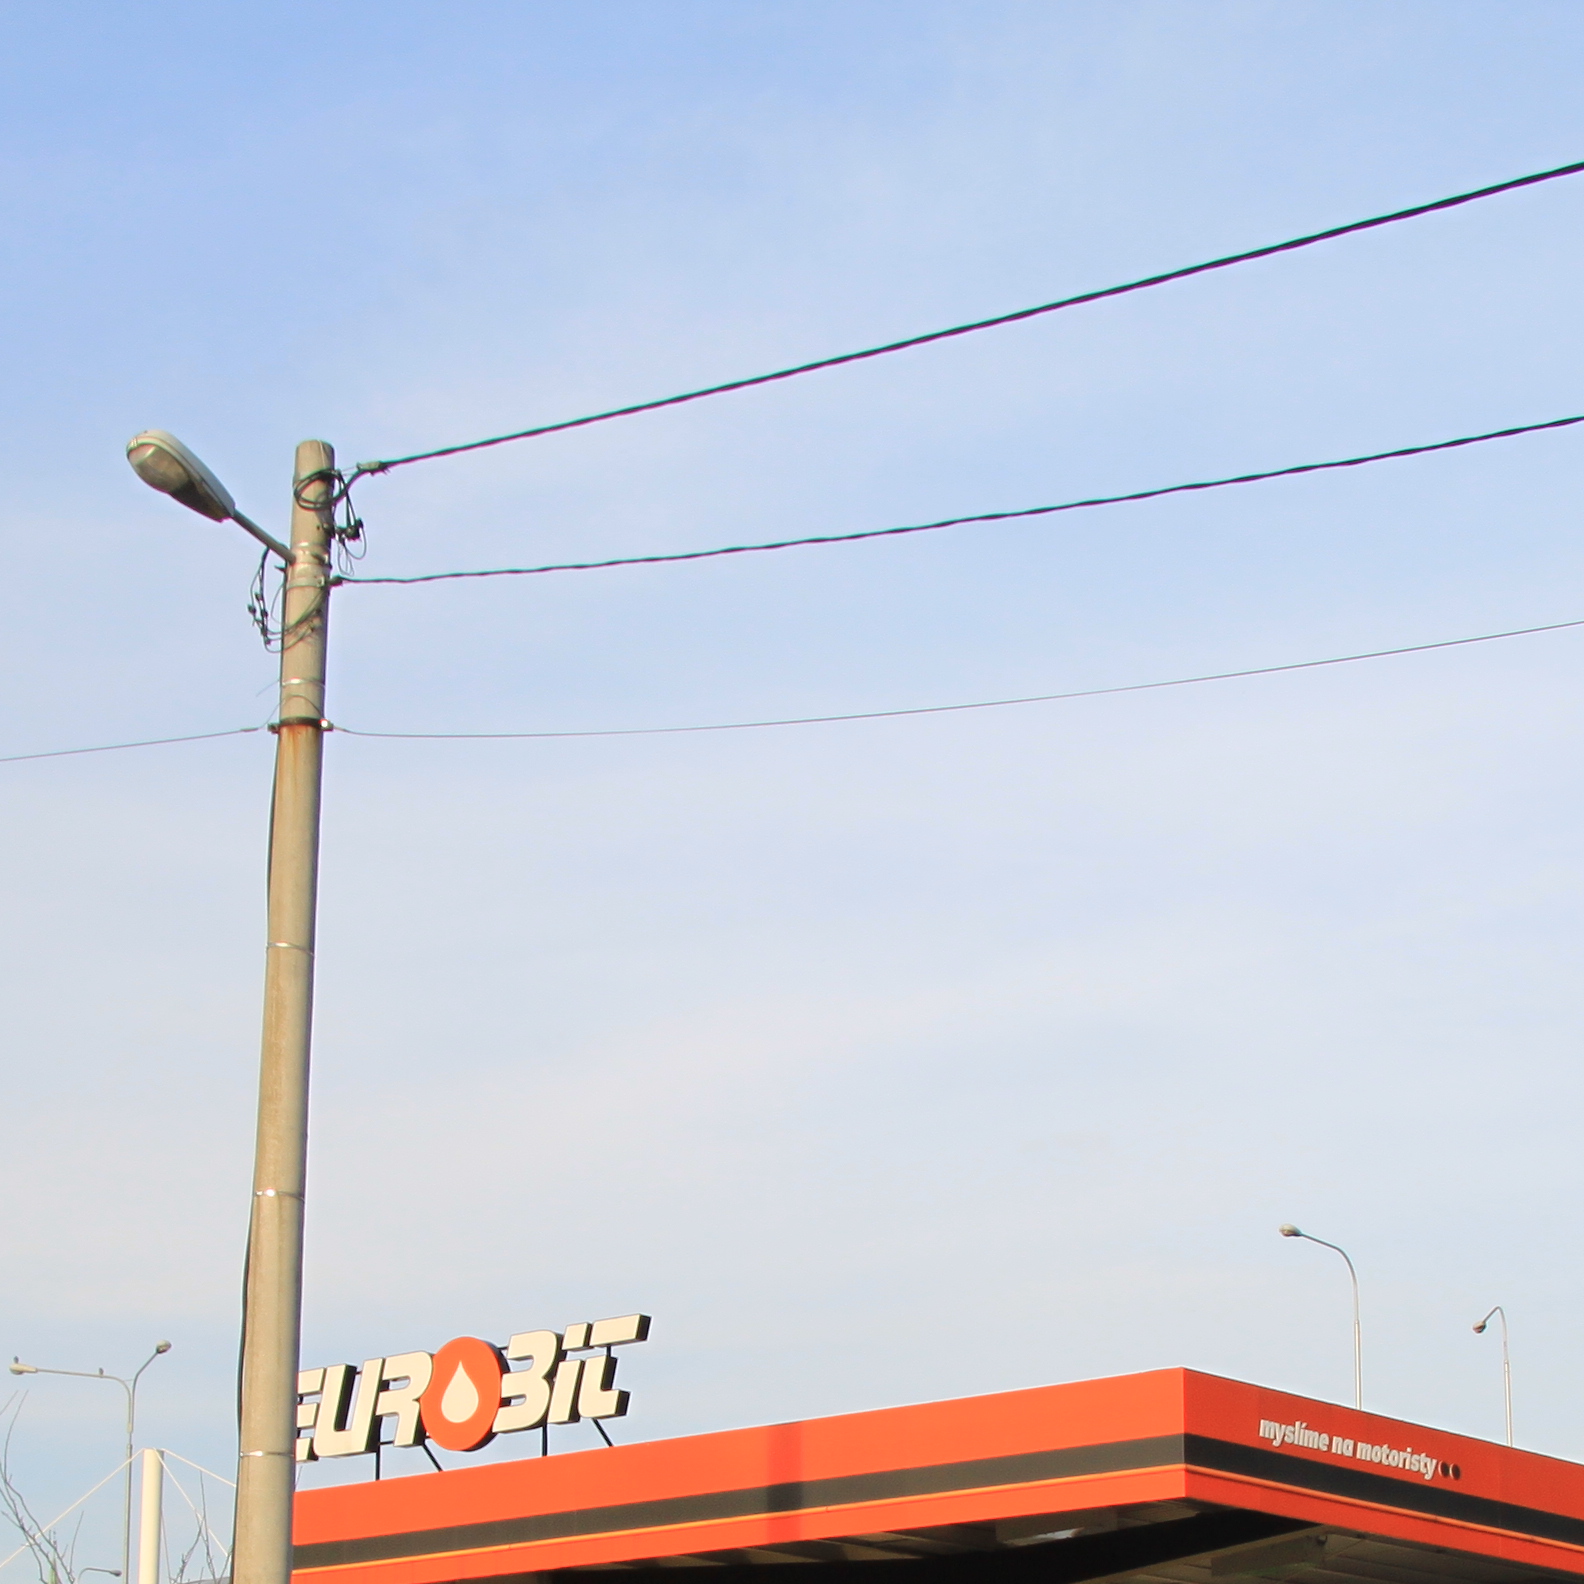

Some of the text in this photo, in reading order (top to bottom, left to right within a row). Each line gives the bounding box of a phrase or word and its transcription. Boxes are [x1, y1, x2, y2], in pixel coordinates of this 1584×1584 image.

[1259, 1418, 1438, 1480] myslíme na motoristy
